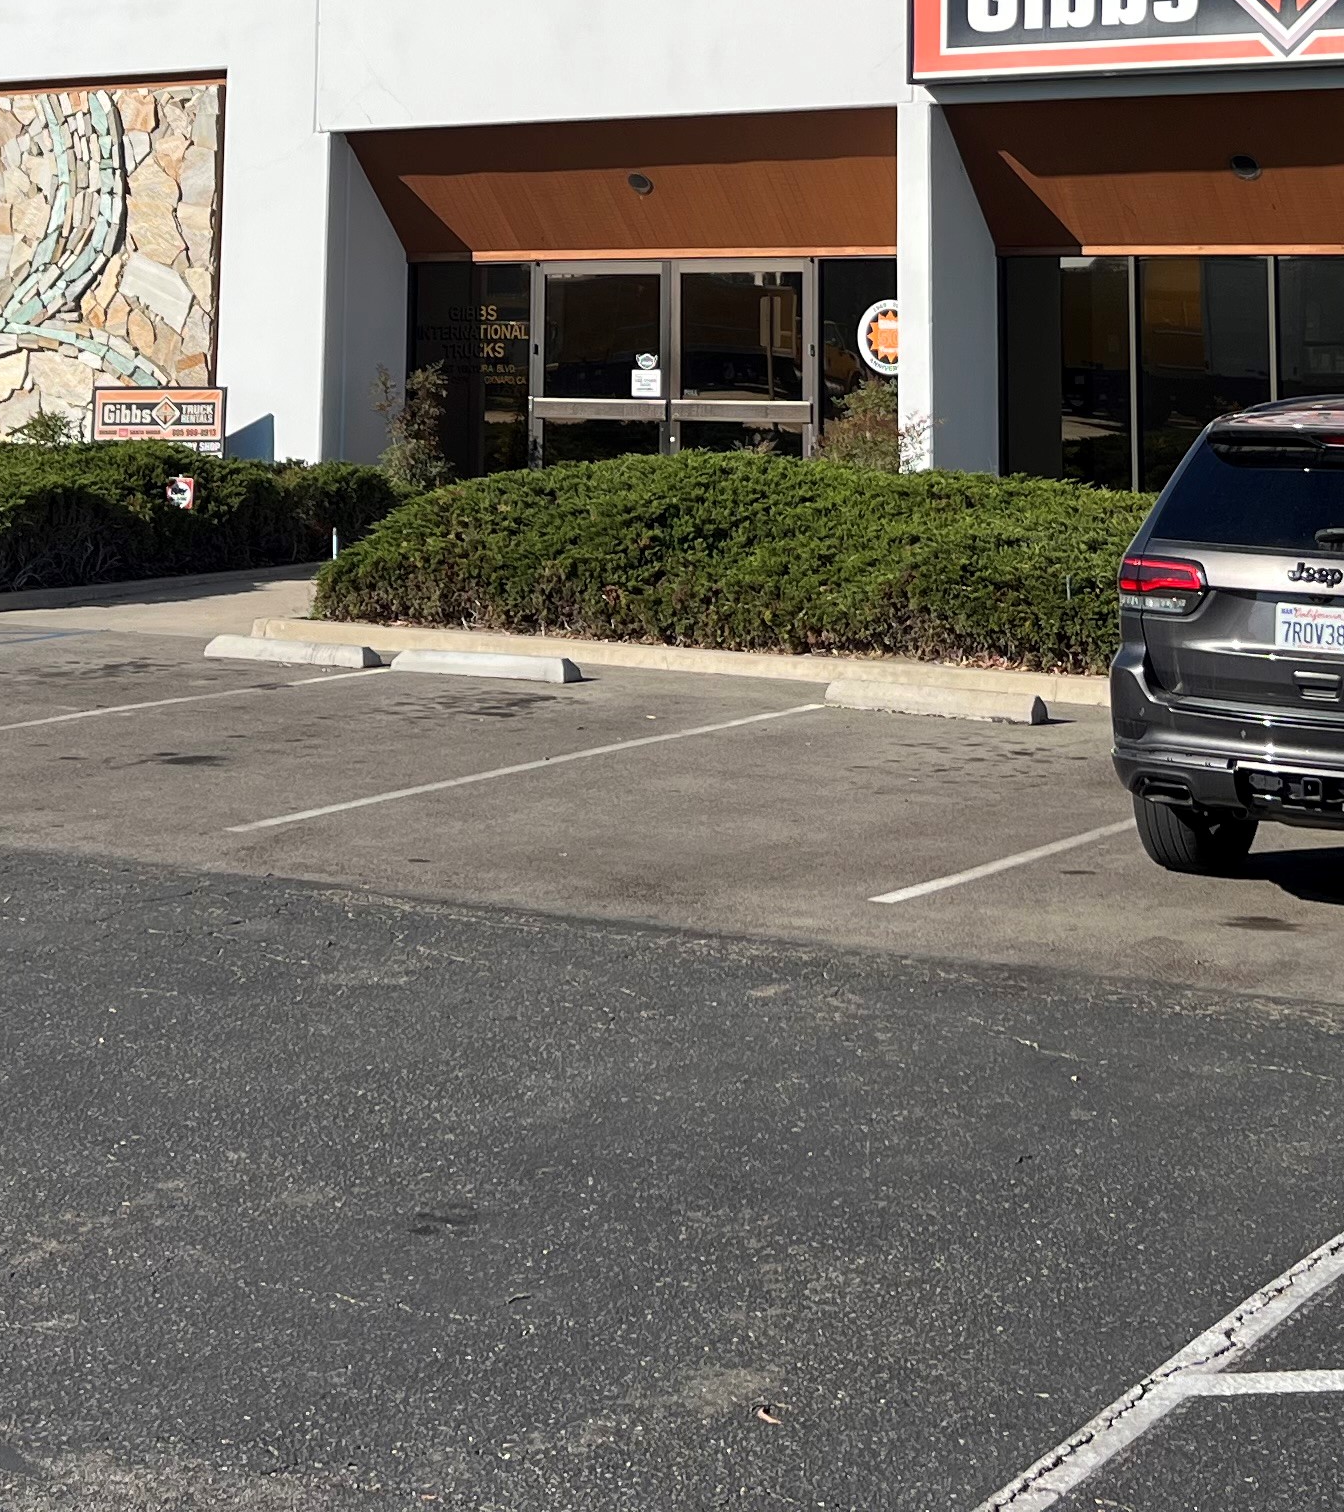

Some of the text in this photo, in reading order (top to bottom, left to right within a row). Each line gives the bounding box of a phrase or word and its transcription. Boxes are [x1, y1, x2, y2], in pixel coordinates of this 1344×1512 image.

[448, 304, 498, 321] GIBBS
[416, 324, 529, 340] INTERNATIONAL
[442, 342, 505, 358] TRUCKS
[103, 404, 151, 423] Gibbs
[181, 404, 213, 414] TRUCK
[181, 414, 213, 423] RENTALS
[1287, 562, 1344, 588] Jeep
[1294, 607, 1342, 622] California
